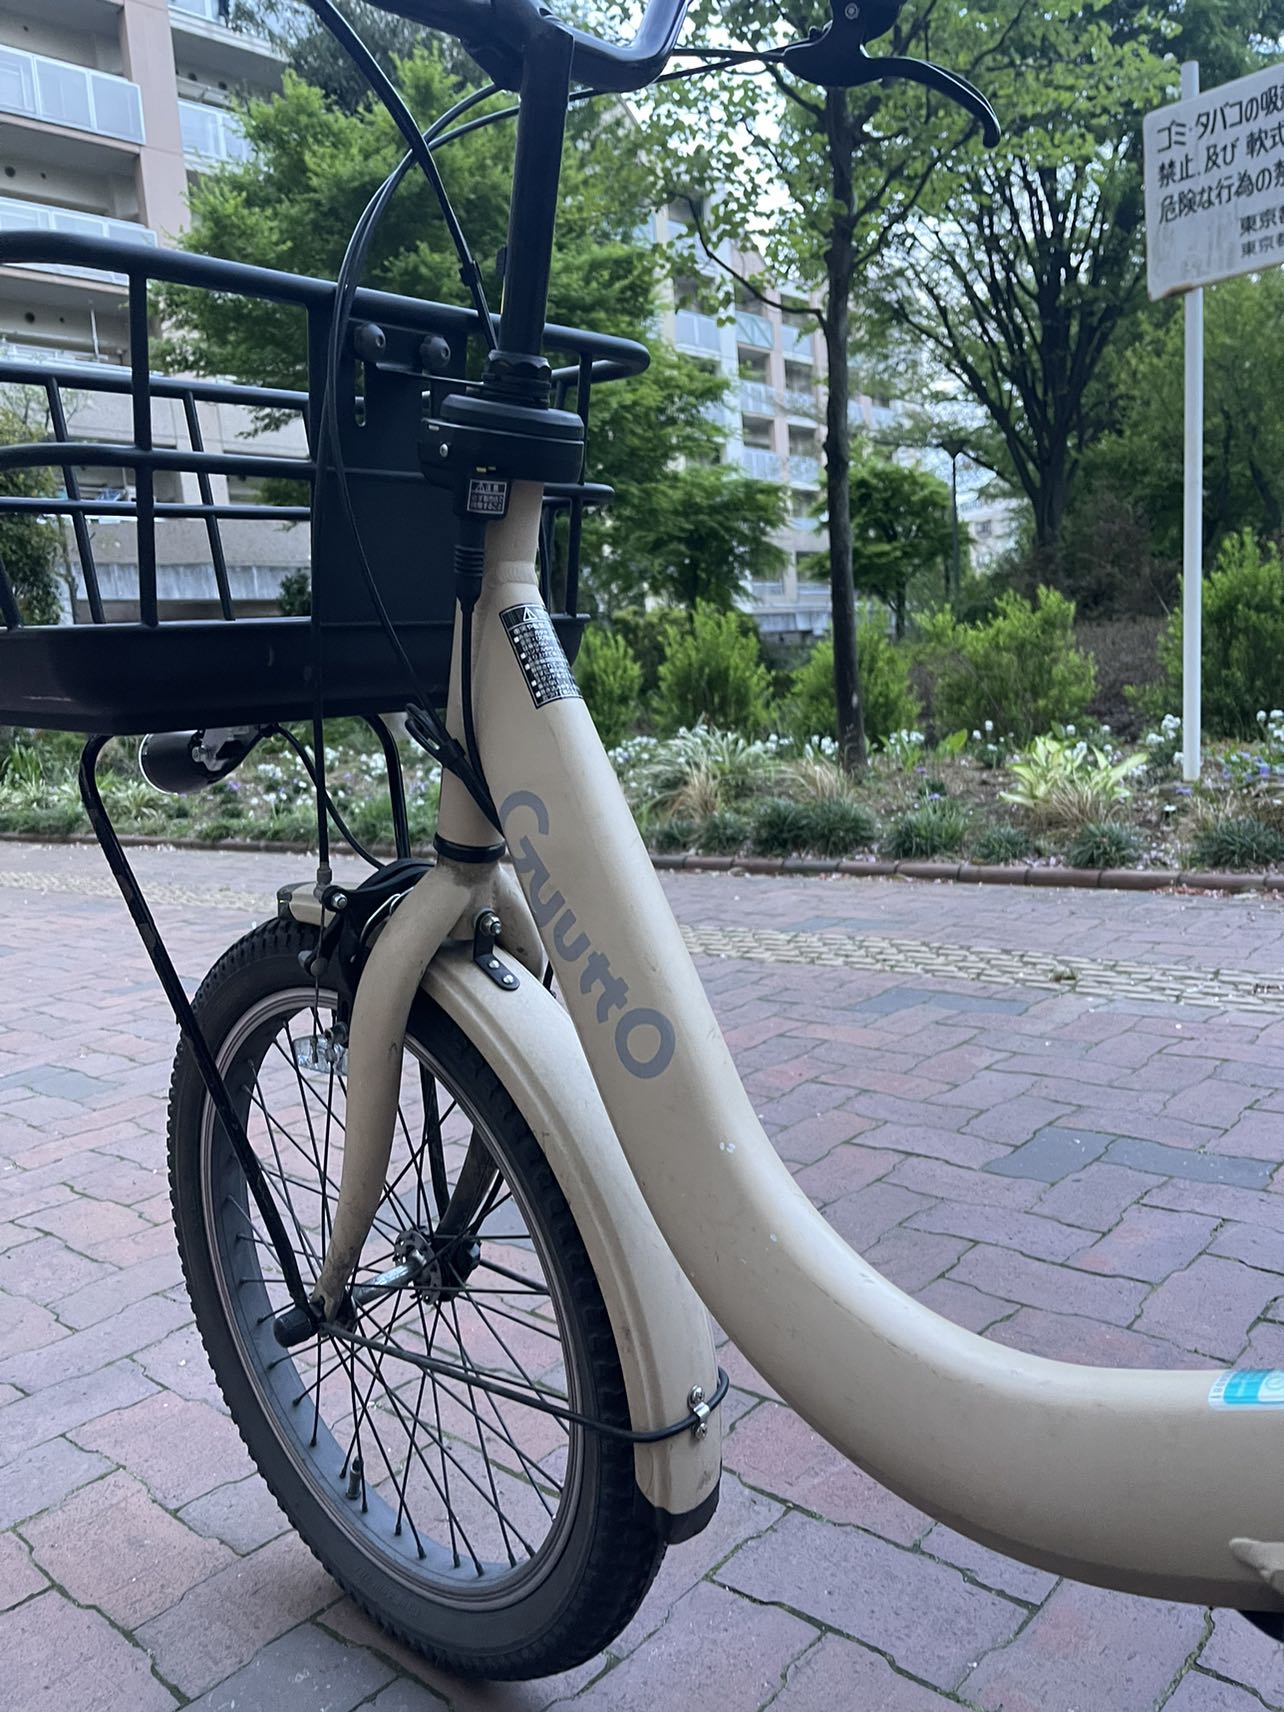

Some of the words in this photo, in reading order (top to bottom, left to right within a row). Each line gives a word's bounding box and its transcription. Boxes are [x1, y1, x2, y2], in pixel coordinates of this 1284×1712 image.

[1157, 84, 1284, 154] ゴミ・タバコの吸
